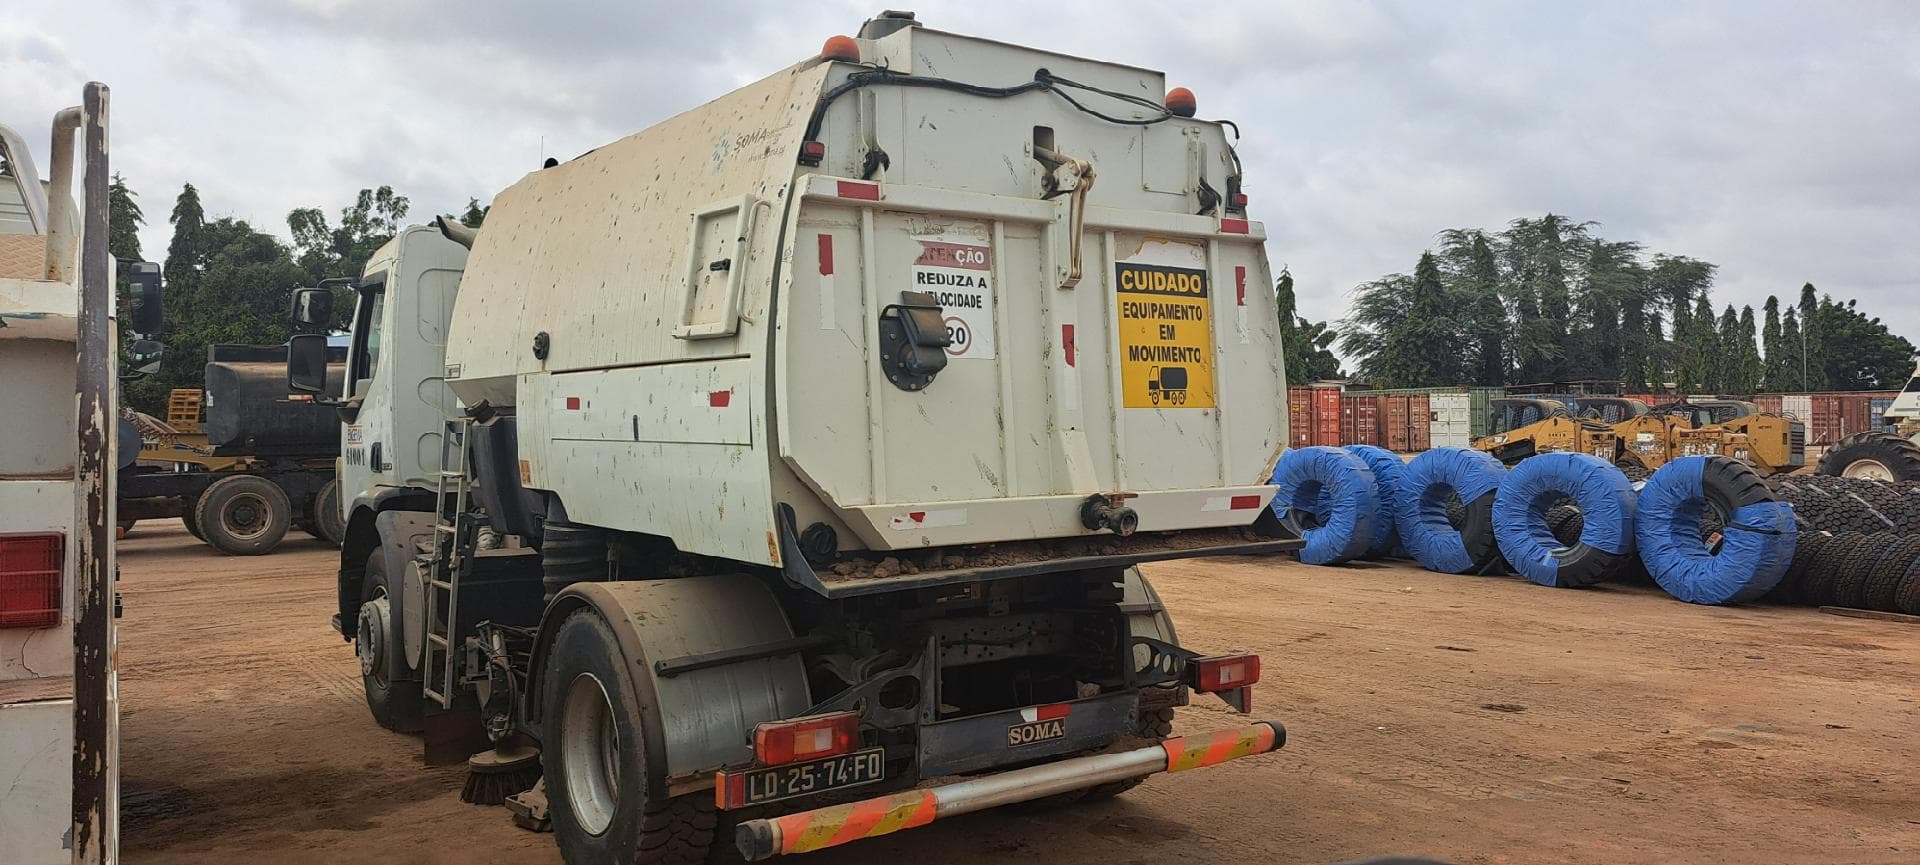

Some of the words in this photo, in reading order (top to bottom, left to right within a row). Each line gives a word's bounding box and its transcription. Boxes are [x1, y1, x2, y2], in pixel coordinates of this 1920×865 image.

[734, 128, 767, 151] SOMA
[917, 271, 974, 288] REDUZA
[978, 277, 987, 289] A
[1121, 270, 1202, 294] CUIDADO
[921, 290, 982, 309] LOCIDADE
[1123, 302, 1203, 321] EQUIPAMENTO
[946, 326, 966, 345] 20
[1159, 324, 1176, 340] EM
[1129, 345, 1201, 363] MOVIMENTO
[1010, 721, 1063, 745] SOMA
